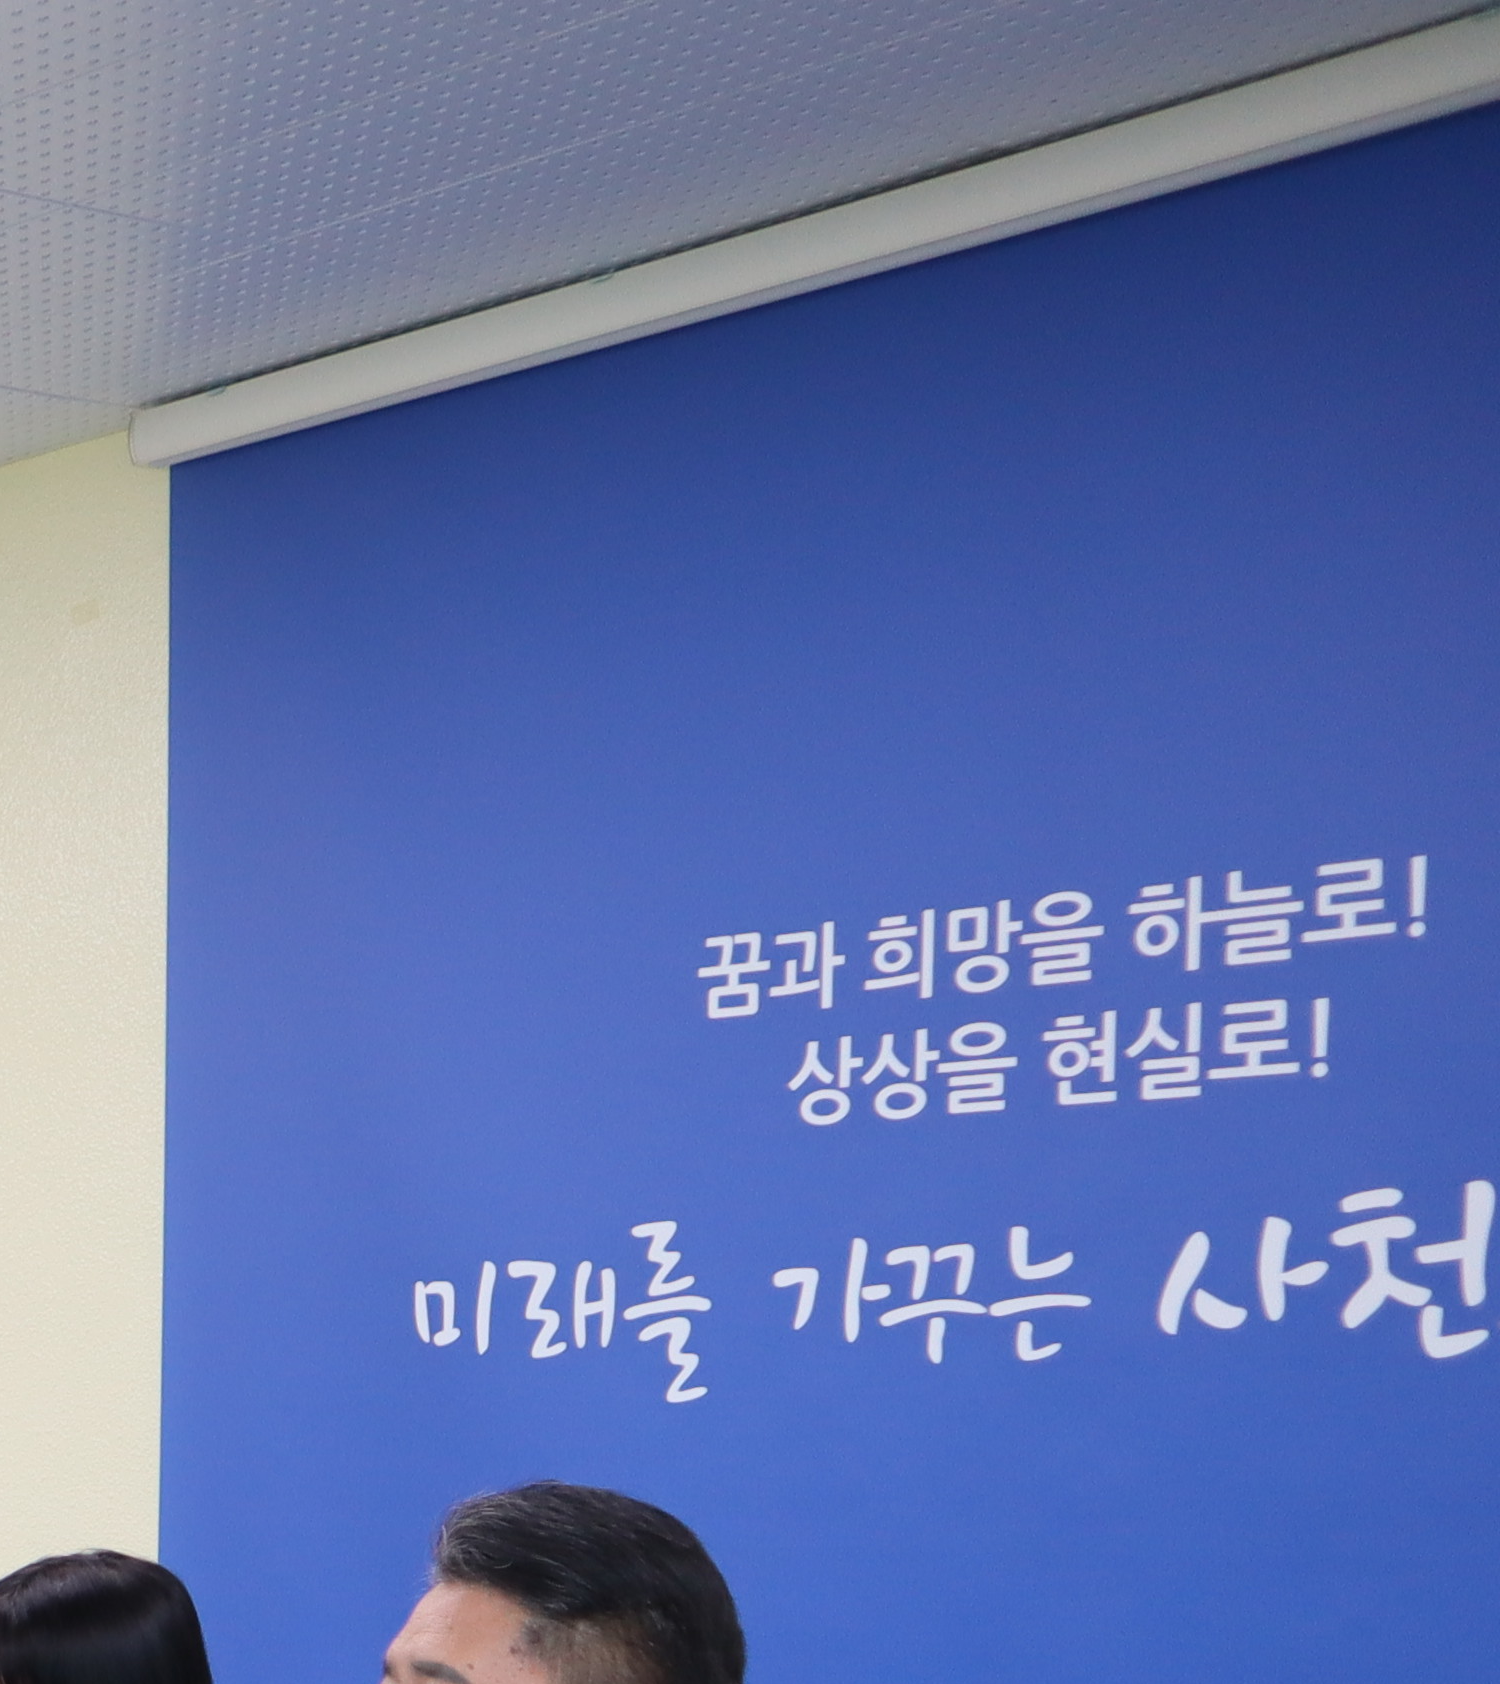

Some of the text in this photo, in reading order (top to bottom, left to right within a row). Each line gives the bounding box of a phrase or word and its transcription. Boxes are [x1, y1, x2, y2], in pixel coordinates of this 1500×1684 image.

[697, 855, 1426, 1019] 꿈과 희망을 하늘로!
[787, 997, 1329, 1126] 상상을 현실로!
[414, 1180, 1496, 1403] 미래를 가꾸는 사천
